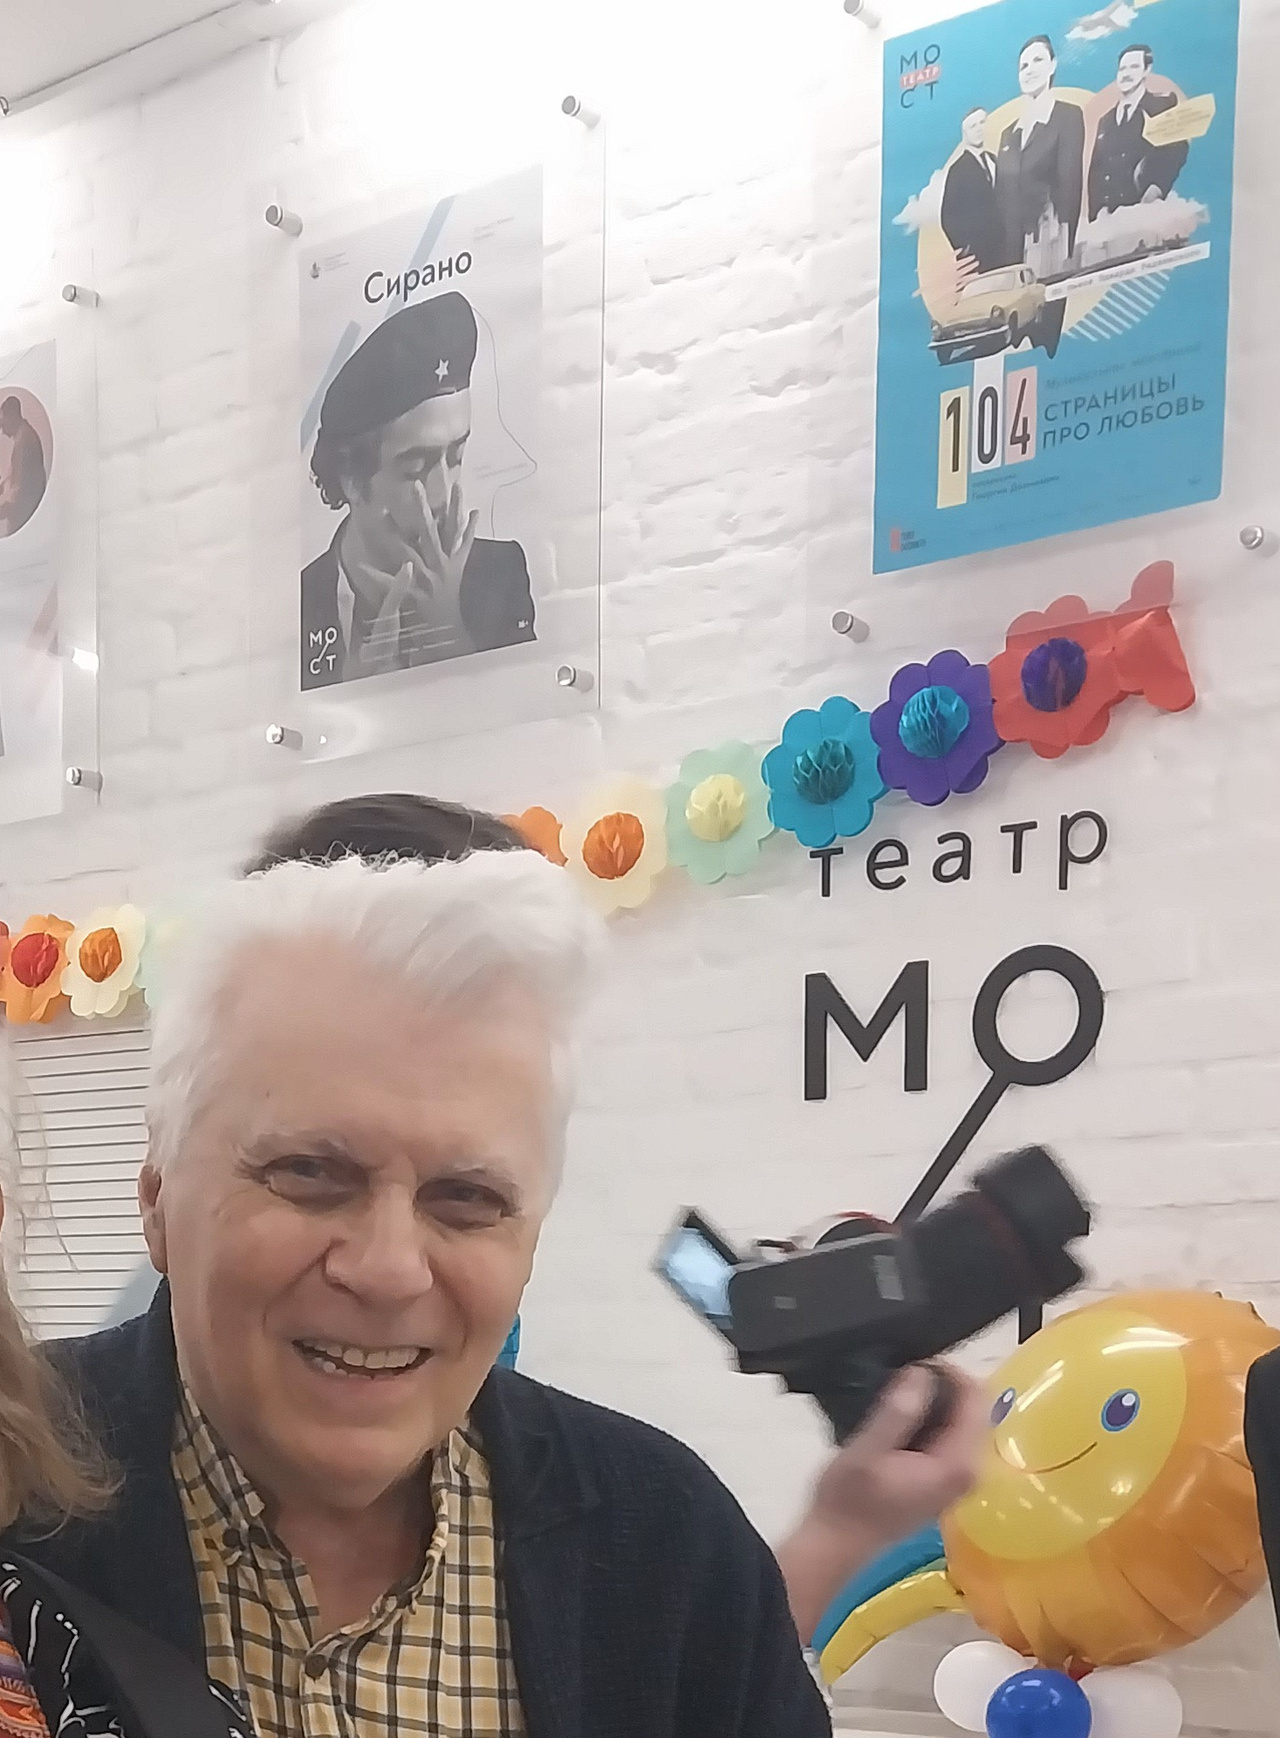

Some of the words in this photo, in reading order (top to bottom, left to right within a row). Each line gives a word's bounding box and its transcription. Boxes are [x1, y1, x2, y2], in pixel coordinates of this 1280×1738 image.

[364, 251, 473, 304] Сирано
[1043, 422, 1090, 449] ПРО
[1097, 394, 1205, 436] ЛЮБОВЬ
[1044, 372, 1176, 422] СТРАНИЦЫ
[945, 377, 1031, 473] 104
[810, 810, 1108, 897] театр
